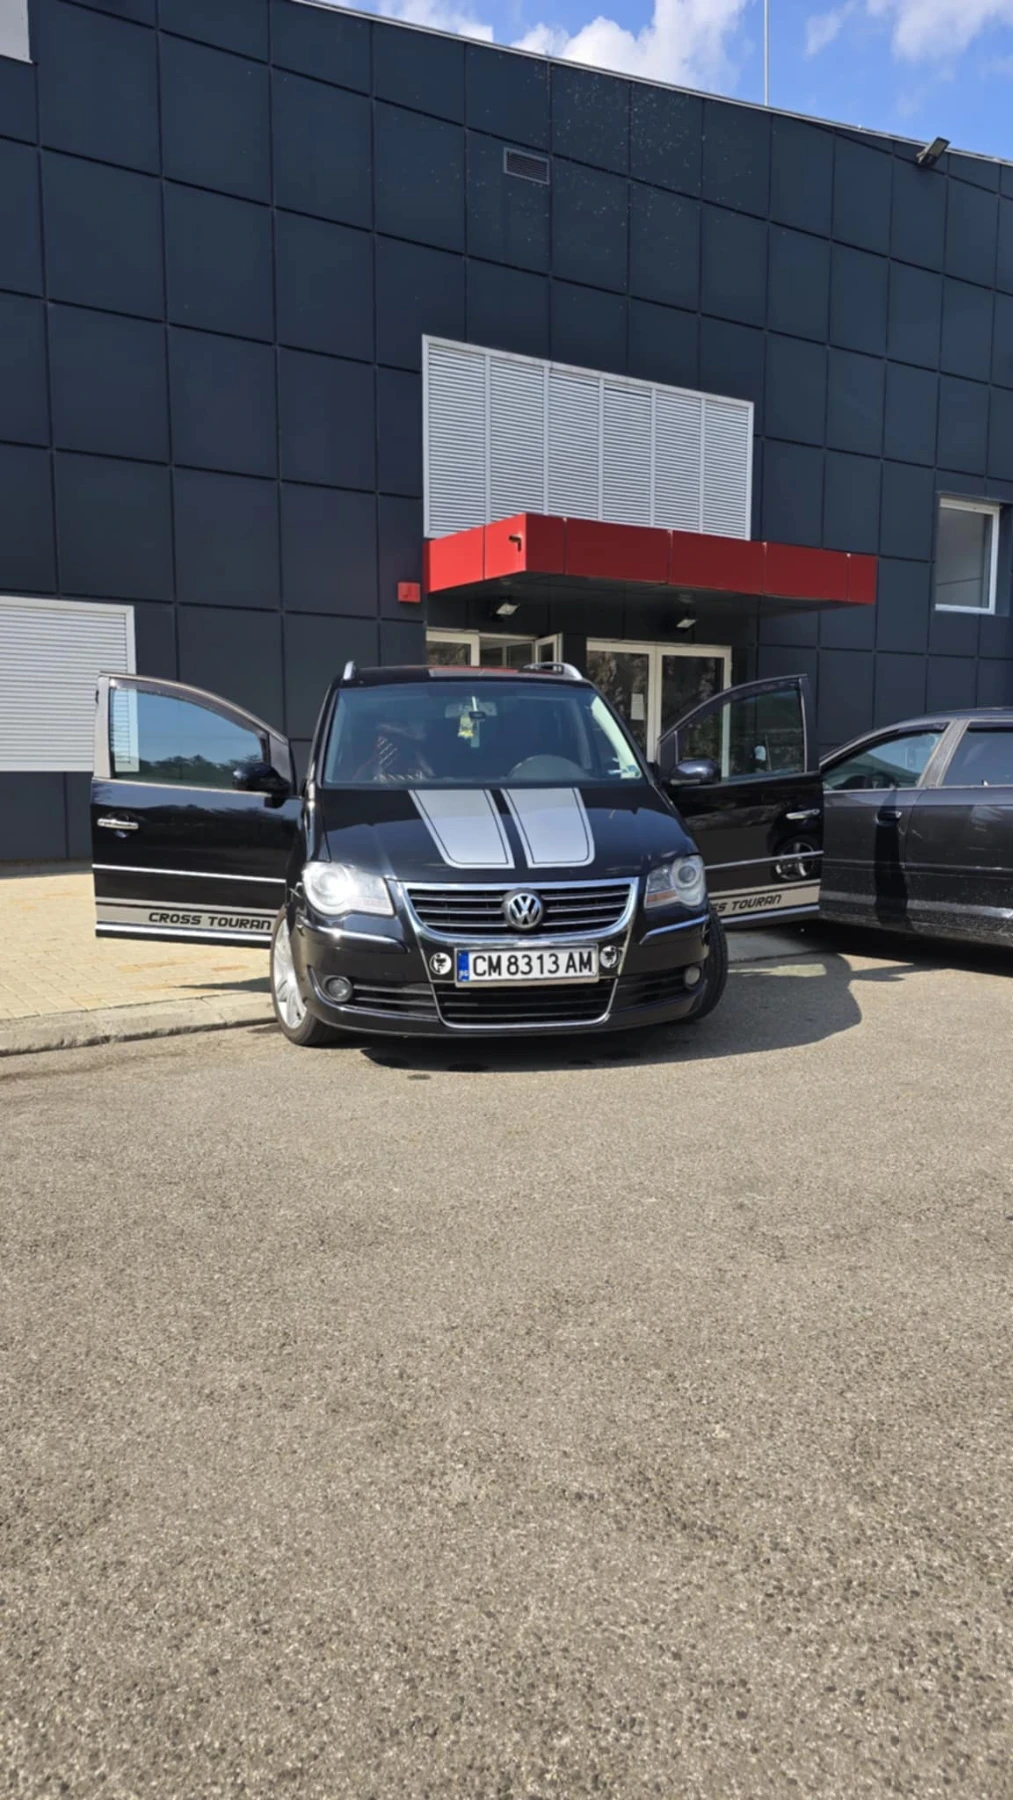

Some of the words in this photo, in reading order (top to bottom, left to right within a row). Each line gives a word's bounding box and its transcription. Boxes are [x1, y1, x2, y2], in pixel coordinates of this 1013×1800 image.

[731, 894, 782, 911] TOURAN
[149, 912, 202, 925] CROSS
[208, 916, 271, 930] TOURAN
[472, 955, 502, 976] CM
[506, 953, 560, 976] 8313
[565, 951, 593, 974] AM
